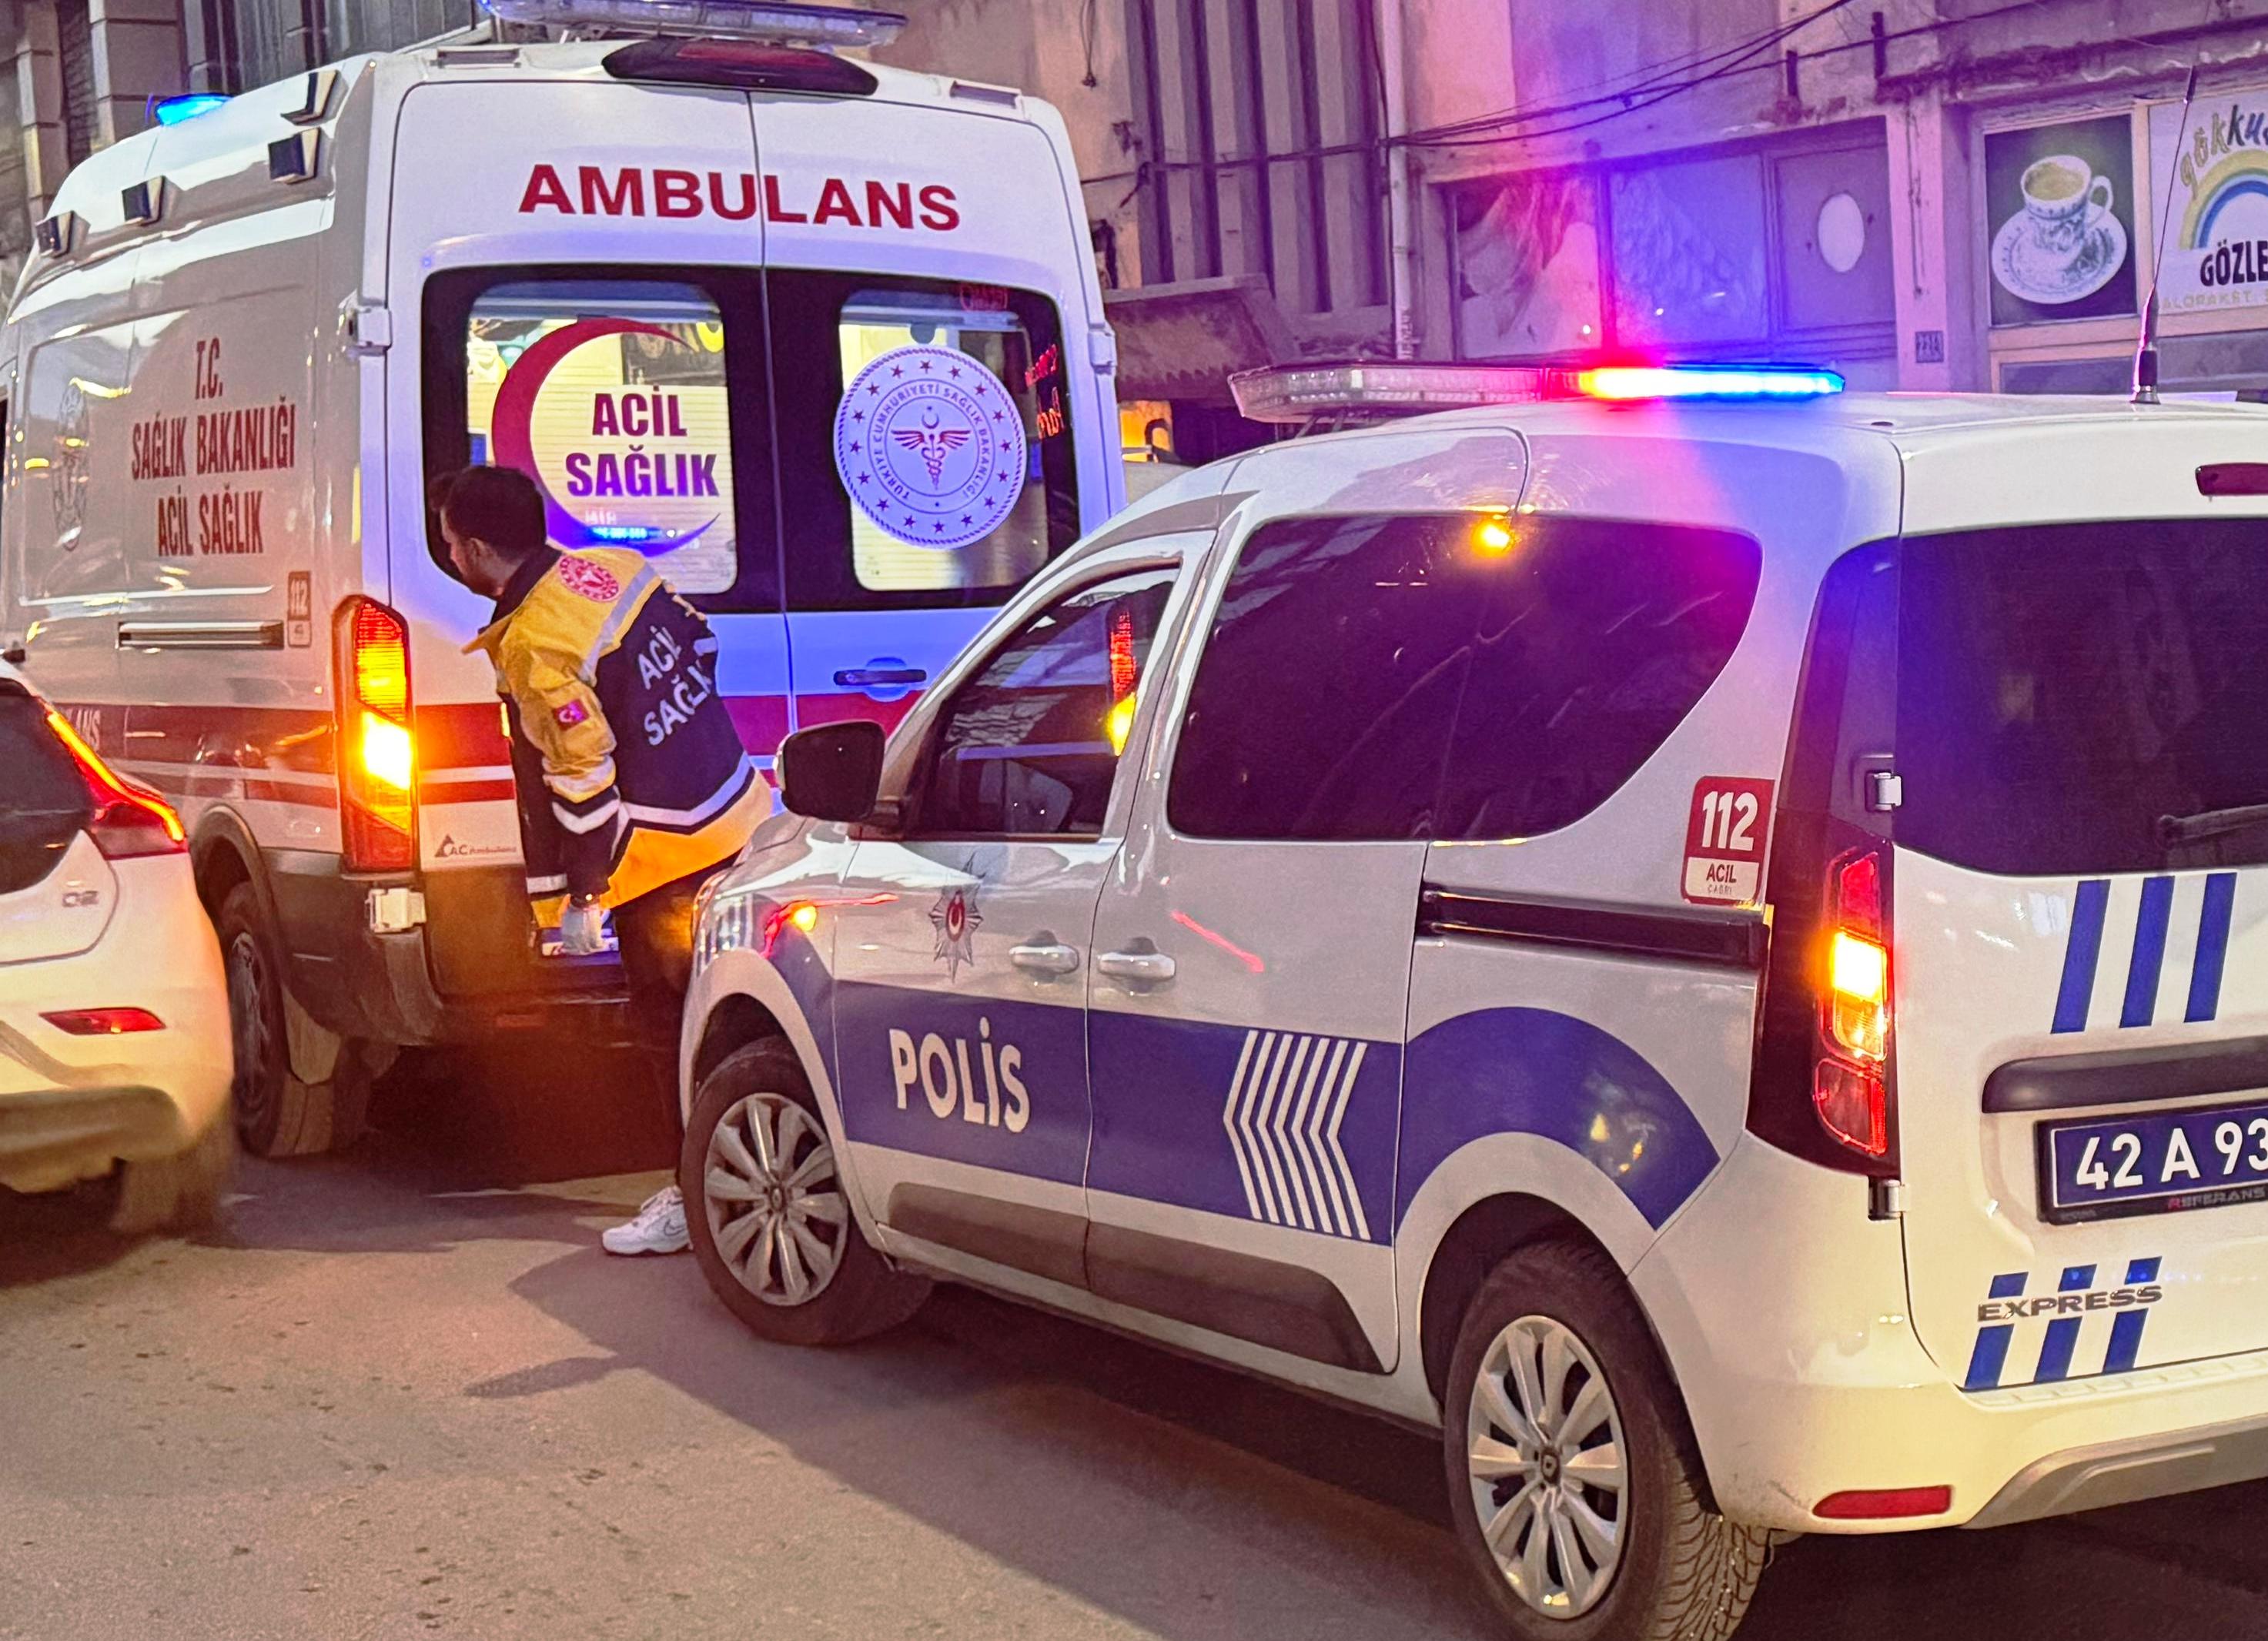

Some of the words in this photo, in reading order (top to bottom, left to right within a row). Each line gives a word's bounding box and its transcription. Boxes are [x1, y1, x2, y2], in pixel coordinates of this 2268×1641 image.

[518, 163, 961, 232] AMBULANS
[195, 337, 223, 399] T.C.
[132, 410, 187, 480] SAĞLIK
[196, 393, 296, 475] BAKANLIĞI
[592, 385, 687, 437] ACİL
[565, 444, 720, 497] SAĞLIK
[158, 484, 194, 556] ACİL
[199, 482, 263, 555] SAĞLIK
[1701, 790, 1758, 852] 112
[889, 1016, 1030, 1133] POLİS
[2076, 1132, 2144, 1191] 42
[2160, 1127, 2201, 1183] A
[1978, 1285, 2163, 1322] EXPRESS
